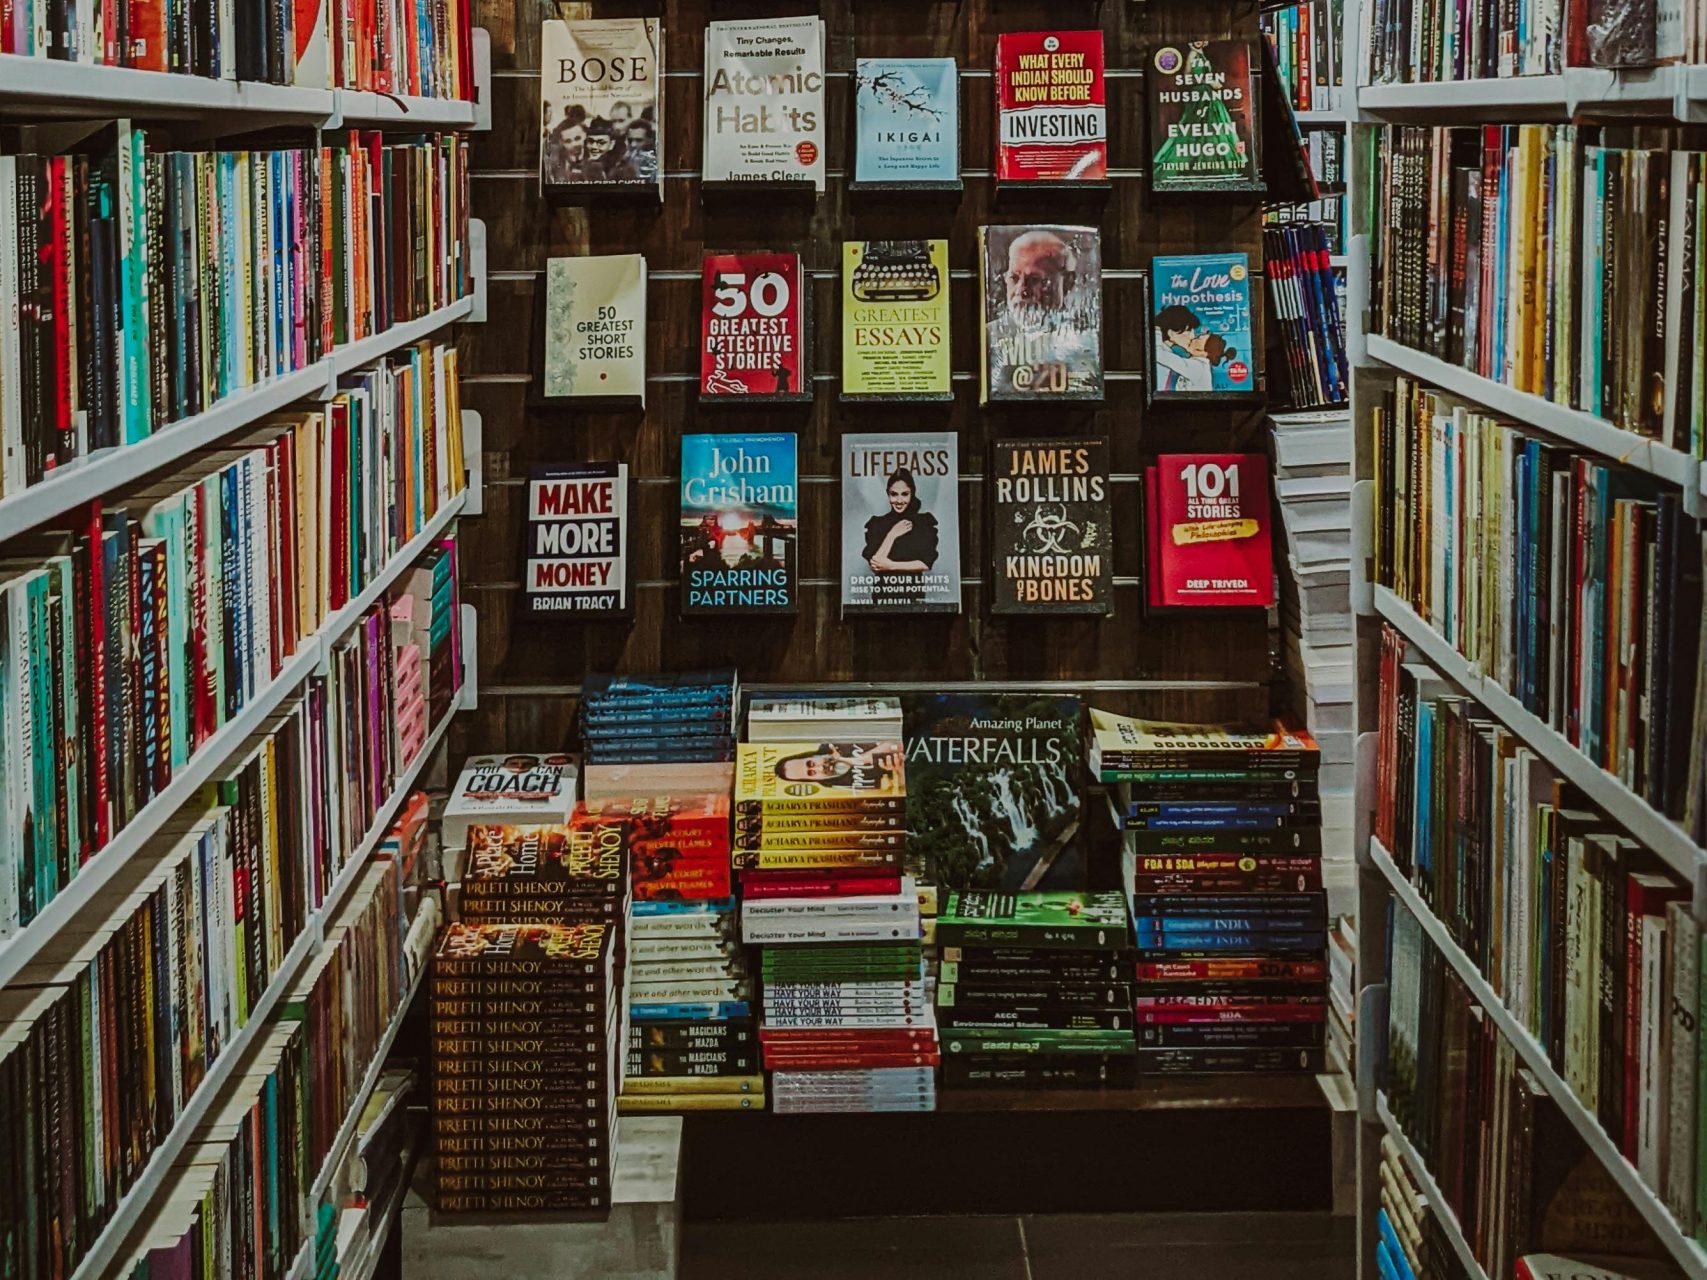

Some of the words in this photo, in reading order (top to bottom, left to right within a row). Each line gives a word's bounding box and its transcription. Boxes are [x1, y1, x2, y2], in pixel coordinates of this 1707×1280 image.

[736, 36, 754, 46] Tiny
[723, 48, 774, 59] Remarkable
[774, 47, 806, 57] Results
[1019, 53, 1049, 70] WHAT
[1051, 52, 1085, 69] EVERY
[557, 56, 649, 85] BOSE
[1011, 70, 1050, 86] INDIAN
[1051, 68, 1094, 85] SHOULD
[1174, 72, 1226, 87] SEVEN
[710, 66, 823, 97] Atomic
[1015, 86, 1048, 102] KNOW
[1051, 85, 1091, 102] BEFORE
[1159, 88, 1243, 104] HUSBANDS
[716, 104, 817, 135] Habits
[1196, 105, 1209, 119] of
[1009, 112, 1098, 138] INVESTING
[1167, 121, 1237, 139] EVELYN
[877, 131, 941, 143] IKIGAI
[1175, 141, 1231, 158] HUGO
[725, 171, 768, 182] James
[771, 170, 807, 181] Clear
[1170, 273, 1188, 289] the
[1189, 266, 1231, 293] Love
[711, 271, 790, 318] 50
[1161, 291, 1244, 306] Hypothesis
[598, 305, 617, 320] 50
[853, 306, 941, 322] GREATEST
[576, 320, 634, 333] GREATEST
[709, 318, 789, 335] GREATEST
[587, 333, 626, 346] SHORT
[706, 334, 793, 354] DETECTIVE
[855, 326, 942, 347] ESSAYS
[579, 345, 634, 361] STORIES
[715, 351, 783, 370] STORIES
[710, 447, 770, 479] John
[850, 450, 950, 478] LIFEPASS
[1009, 448, 1090, 476] JAMES
[1180, 463, 1240, 498] 101
[537, 481, 613, 516] MAKE
[683, 477, 795, 505] Grisham
[997, 476, 1105, 504] ROLLINS
[1187, 504, 1241, 519] STORIES
[536, 521, 614, 555] MORE
[535, 561, 613, 588] MONEY
[1005, 555, 1101, 578] KINGDOM
[690, 569, 788, 588] SPARRING
[850, 575, 881, 585] DROP
[883, 575, 913, 584] YOUR
[914, 575, 950, 584] LIMITS
[1186, 579, 1210, 589] DEEP
[1211, 579, 1248, 589] TRIVEDI
[689, 589, 789, 607] PARTNERS
[850, 586, 868, 594] RISE
[869, 586, 880, 594] TO
[906, 585, 950, 593] POTENTIAL
[1026, 578, 1094, 602] BONES
[532, 596, 572, 611] BRIAN
[574, 595, 615, 611] TRACY
[970, 717, 1023, 733] Amazing
[1025, 717, 1062, 730] Planet
[465, 773, 561, 793] COACH
[466, 882, 508, 896] PREETI
[513, 881, 566, 895] SHENOY
[776, 1017, 799, 1026] HAVE
[801, 1017, 823, 1026] YOUR
[824, 1017, 844, 1025] WAY
